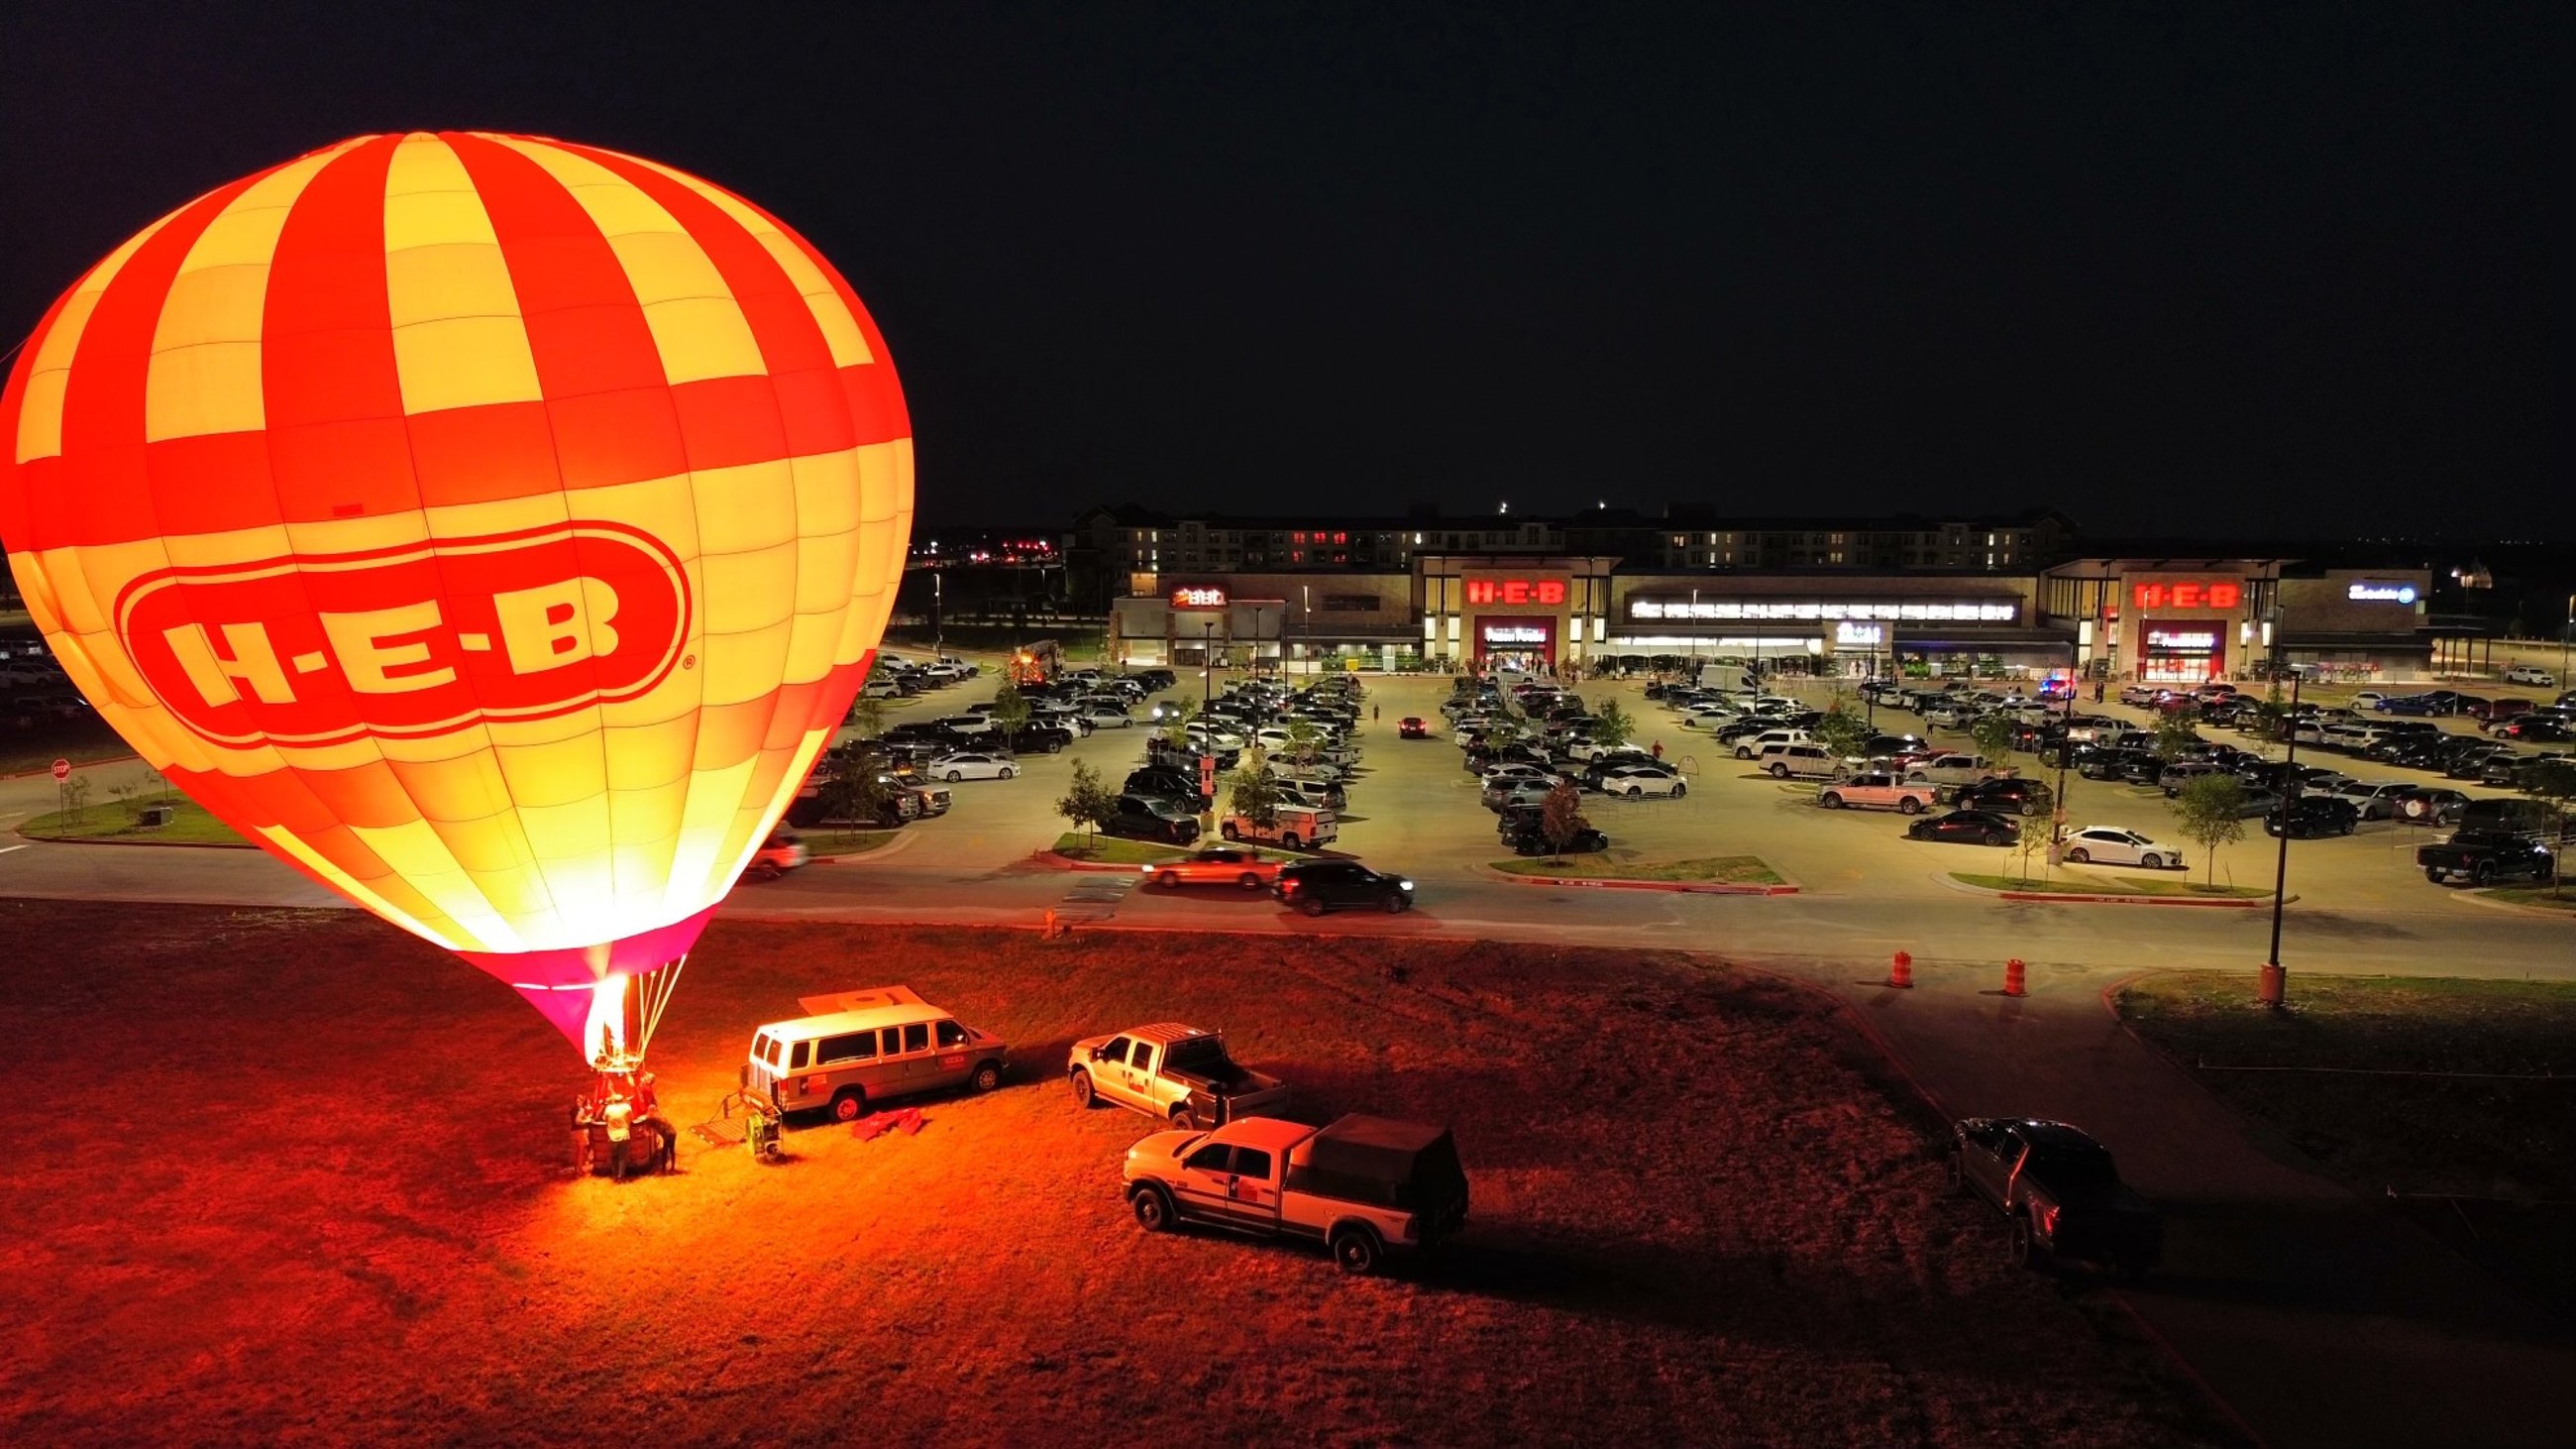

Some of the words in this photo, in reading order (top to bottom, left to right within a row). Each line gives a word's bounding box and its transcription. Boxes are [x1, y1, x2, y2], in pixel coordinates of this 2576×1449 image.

[1468, 581, 1565, 604] H-E-B
[2135, 584, 2239, 608] H-E-B
[161, 575, 620, 708] H-E-B
[54, 764, 69, 774] STOP
